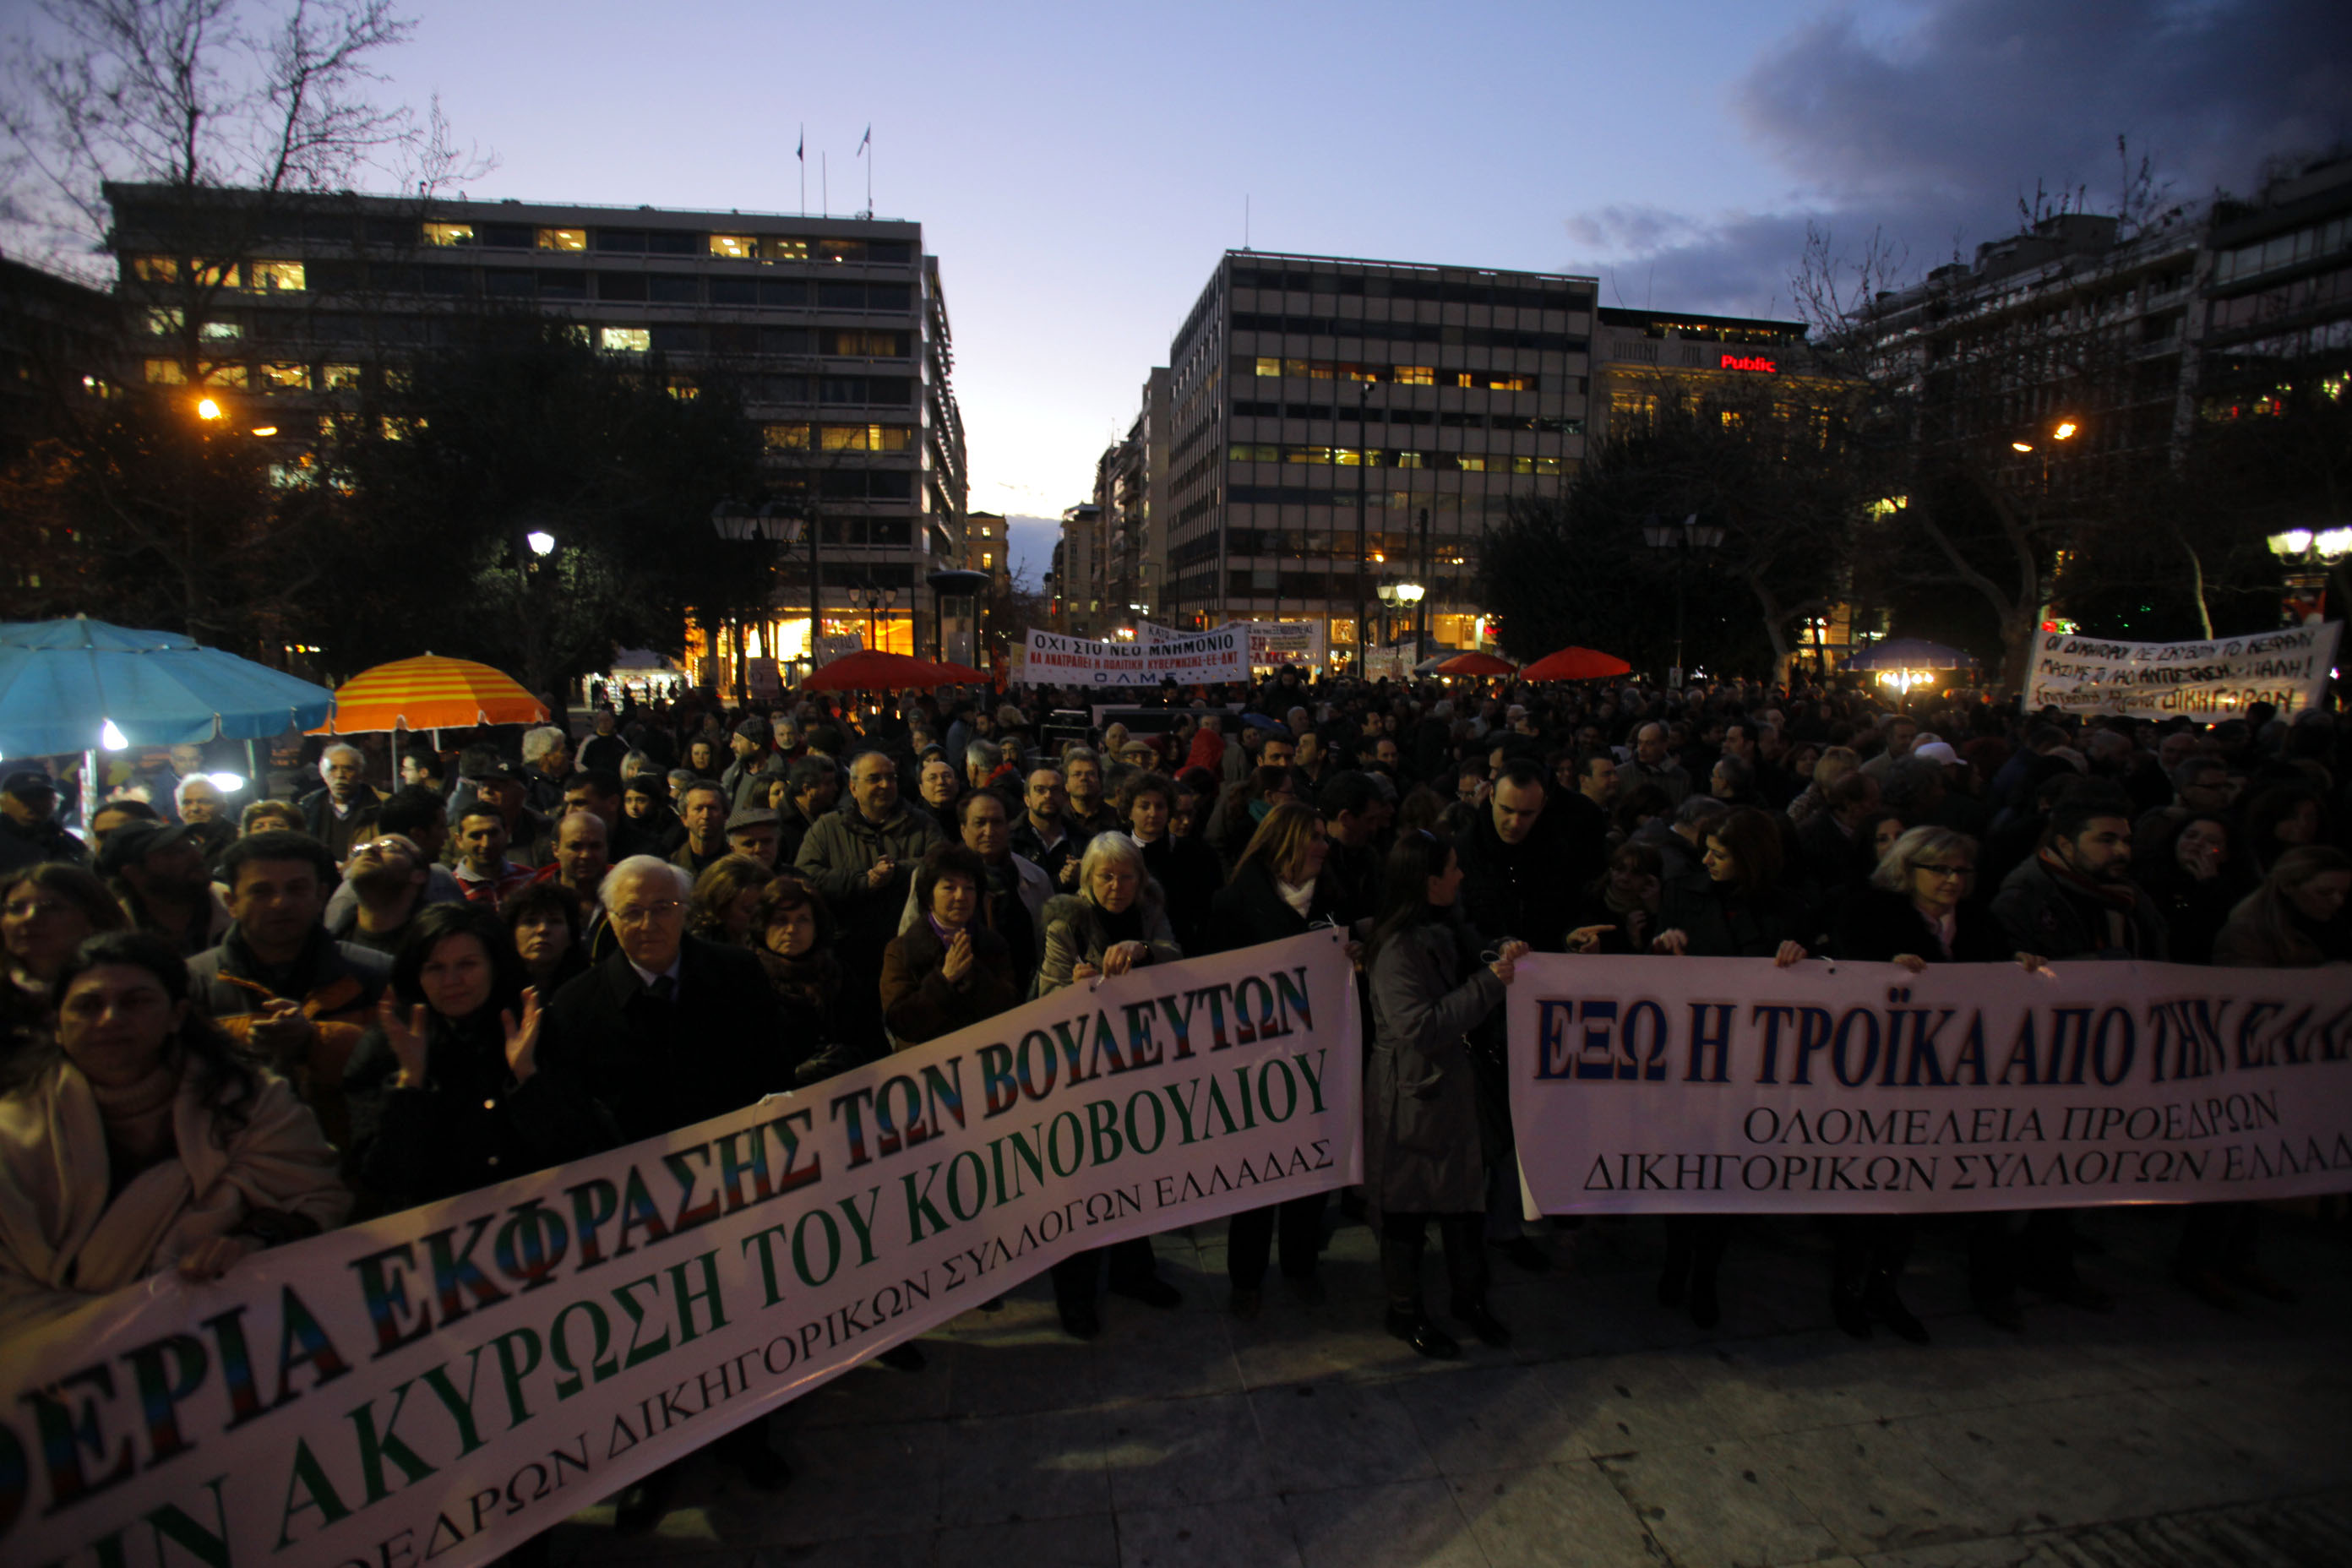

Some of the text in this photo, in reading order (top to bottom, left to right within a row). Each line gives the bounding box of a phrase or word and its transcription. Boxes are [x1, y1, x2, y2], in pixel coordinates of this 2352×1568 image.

[1721, 354, 1777, 373] Public
[1030, 651, 1042, 664] ΝΑ
[1035, 634, 1233, 656] ΟΧΙ ΣΤΟ ΝΕΟ ΜΝΗΜΟΝΙΟ
[1533, 999, 1668, 1081] ΕΞΩ
[1682, 1003, 1738, 1083] Η
[1752, 986, 1989, 1087] ΤΡΟΪΚΑ
[1997, 1005, 2135, 1086] ΑΠΟ
[2147, 999, 2233, 1083] ΤΗΝ
[1744, 1090, 2281, 1146] ΟΛΟΜΕΛΕΙΑ ΠΡΟΕΔΡΩΝ
[1583, 1153, 1942, 1191] ΔΙΚΗΓΟΡΙΚΩΝ
[1950, 1148, 2211, 1190] ΣΥΛΛΟΓΩΝ
[0, 966, 1314, 1539] ΕΡΙΑ ΕΚΦΡΑΣΗΣ ΤΩΝ ΒΟΥΛΕΥΤΩΝ
[271, 1248, 732, 1553] ΑΚΥΡΩΣΗ
[742, 1185, 881, 1309] ΤΟΥ
[900, 1048, 1328, 1245] ΚΟΙΝΟΒΟΥΛΙΟΥ
[334, 1139, 1334, 1568] ΕΔΡΩΝ ΔΙΚΗΓΟΡΙΚΩΝ ΣΥΛΛΟΓΩΝ ΕΛΛΑΔΑΣ
